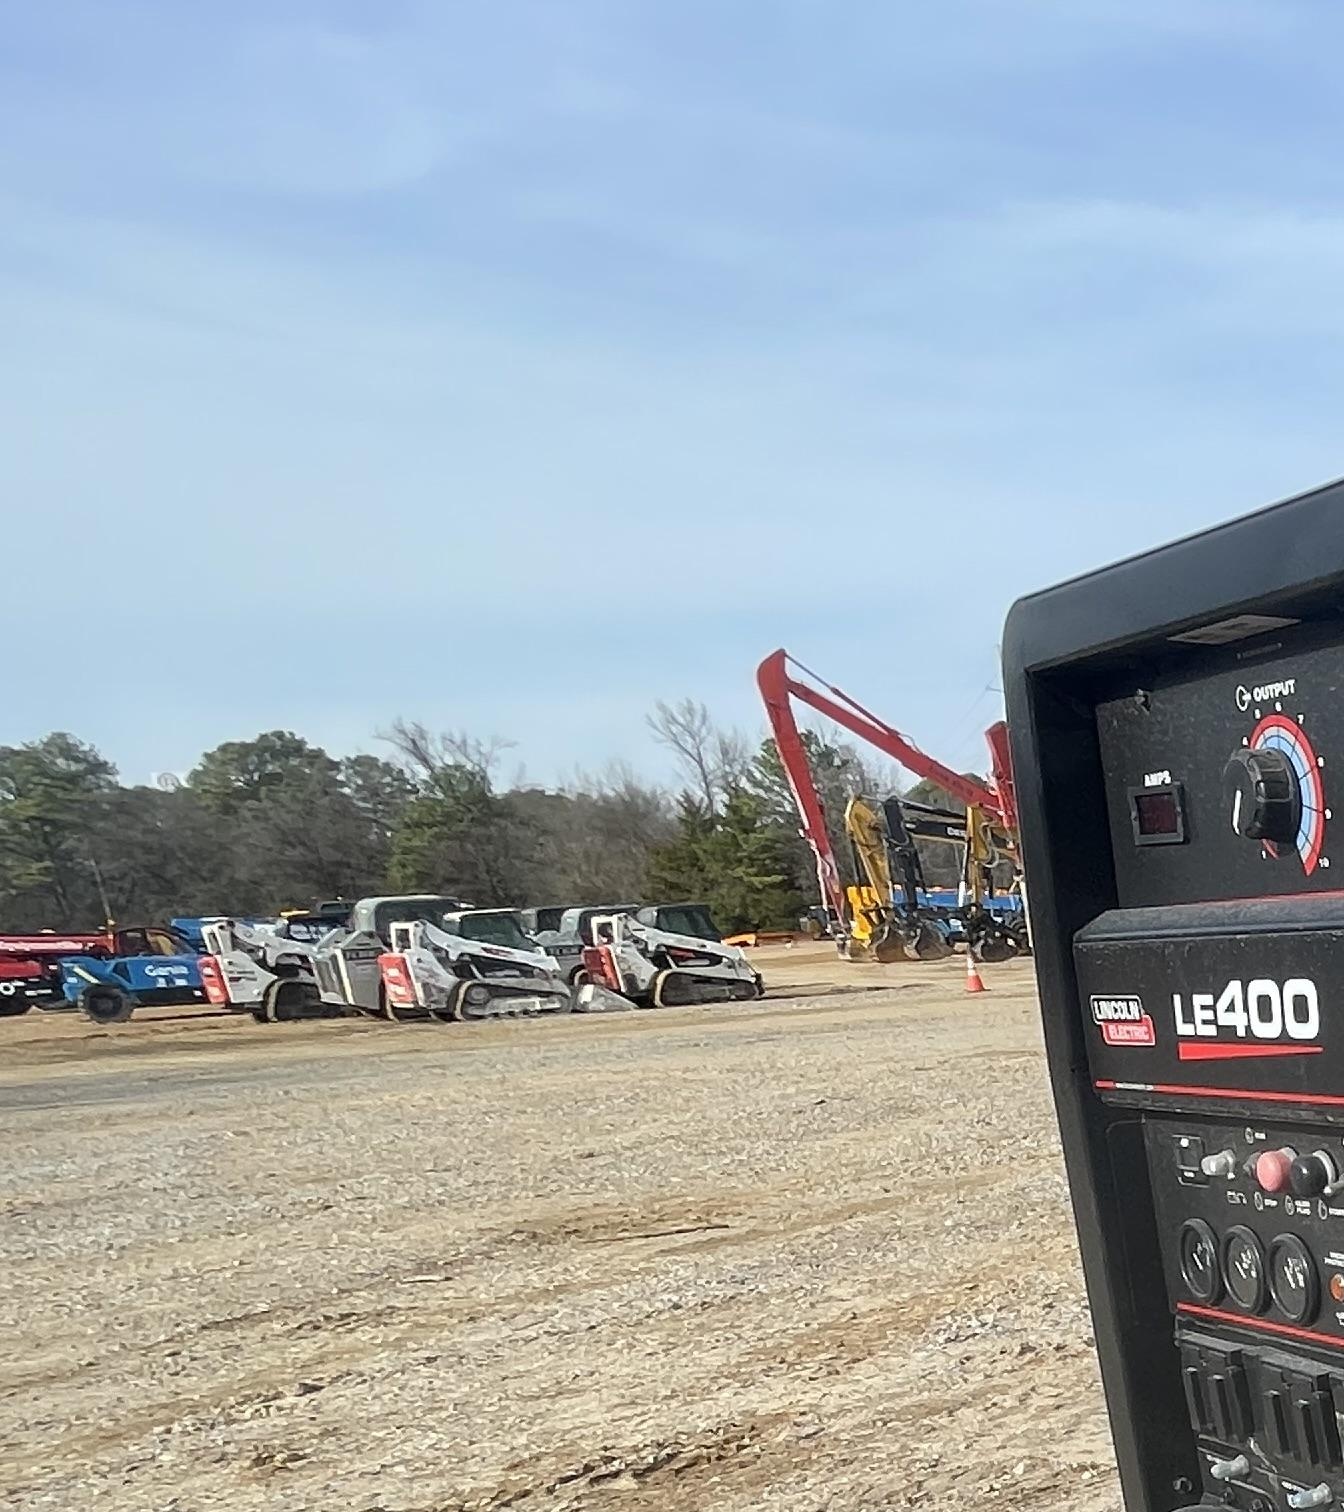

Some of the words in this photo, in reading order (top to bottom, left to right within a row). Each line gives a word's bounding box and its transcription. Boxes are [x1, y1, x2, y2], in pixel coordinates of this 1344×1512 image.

[1252, 679, 1296, 702] OUTPUT
[1144, 770, 1172, 787] AMPS
[1318, 857, 1330, 868] 10
[1093, 1000, 1140, 1020] LINCOLN
[1172, 978, 1320, 1041] LE400
[1108, 1024, 1151, 1041] ELECTRIC
